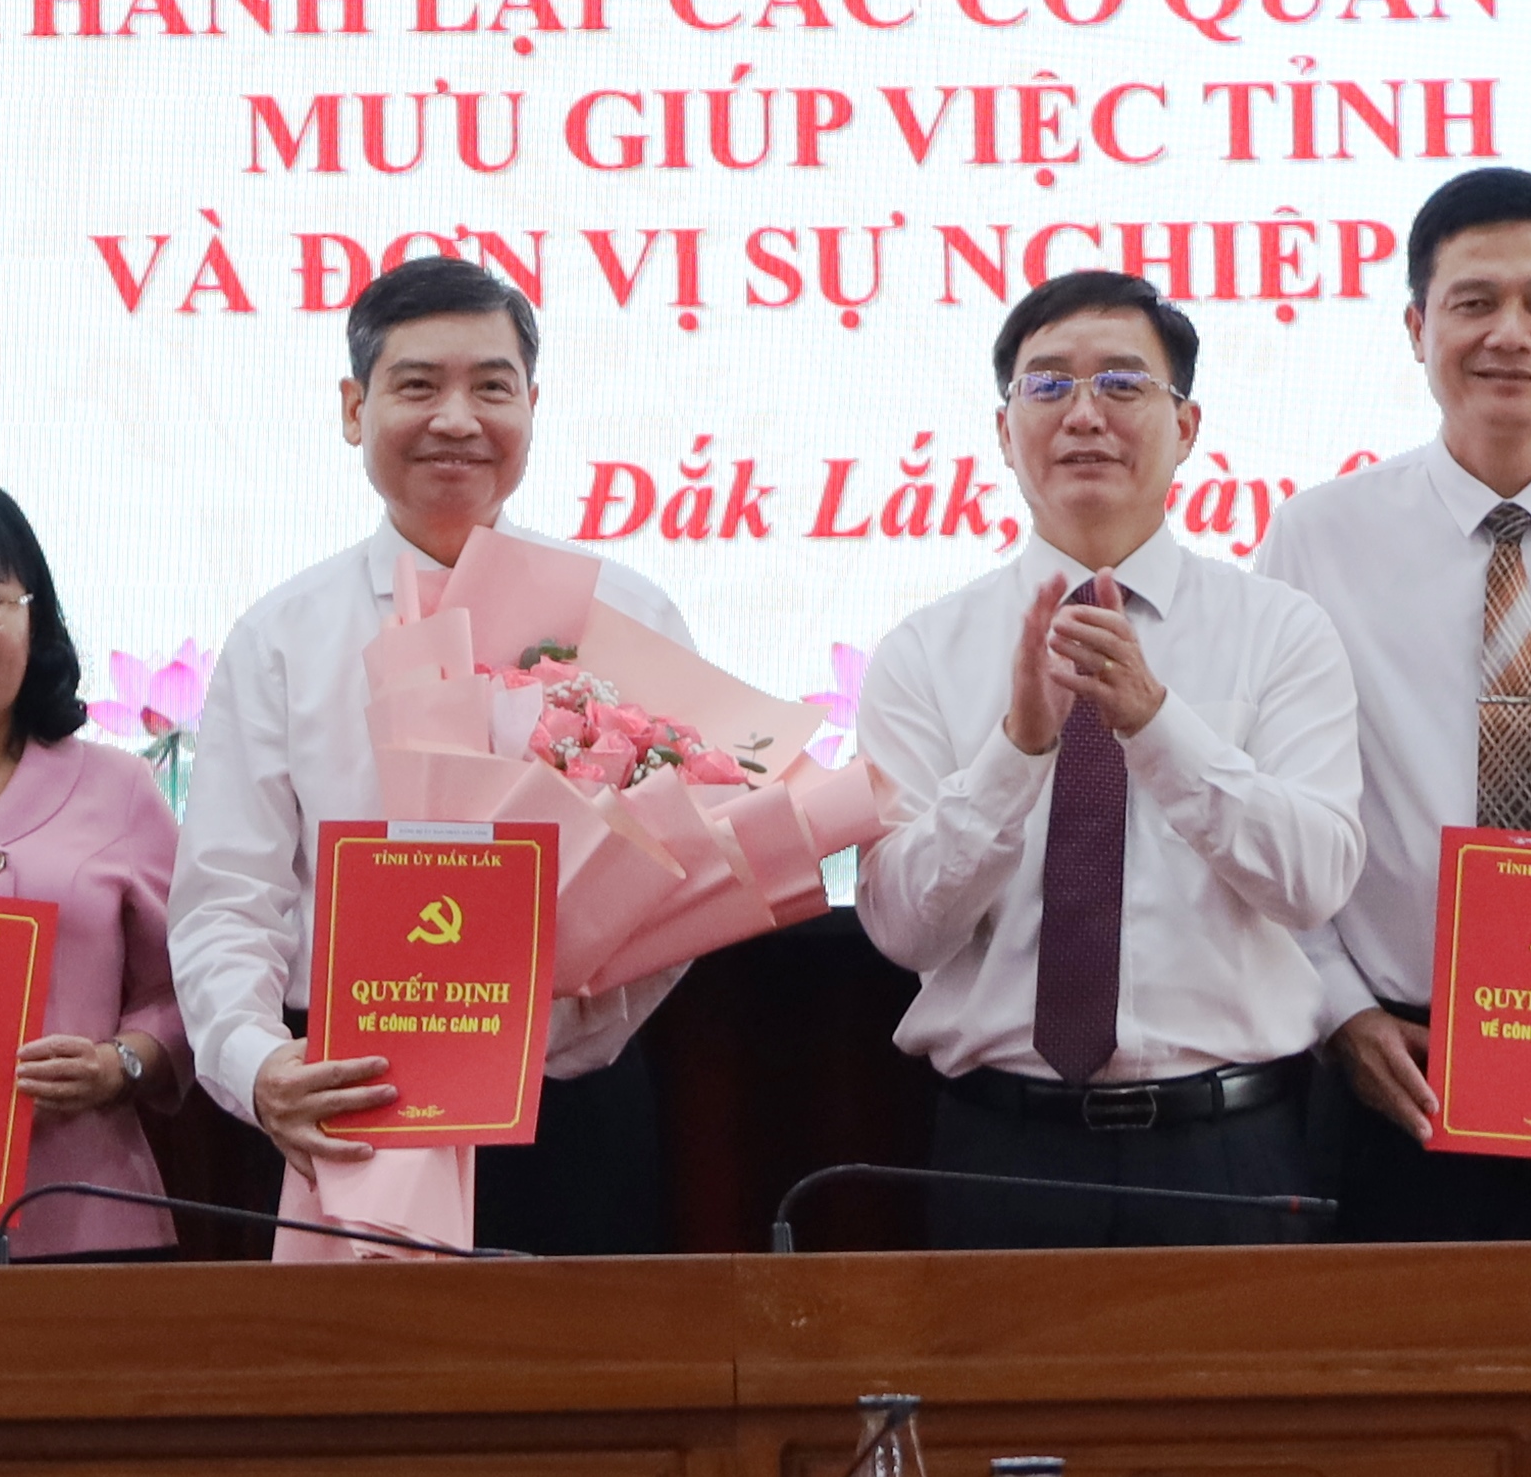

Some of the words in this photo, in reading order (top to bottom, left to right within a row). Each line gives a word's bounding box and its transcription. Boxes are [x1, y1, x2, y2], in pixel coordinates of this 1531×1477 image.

[246, 79, 523, 173] MƯU
[565, 63, 853, 171] GIÚP
[880, 71, 1166, 187] VIỆC
[1205, 57, 1496, 160] TỈNH
[92, 209, 255, 312] VÀ
[582, 229, 701, 331] VỊ
[746, 212, 905, 329] SỰ
[574, 434, 772, 541] Đắk
[808, 432, 1019, 547] Lắk,
[372, 849, 409, 866] TỈNH
[413, 850, 433, 866] ỦY
[351, 972, 439, 1005] QUYẾT
[445, 982, 510, 1008] ĐỊNH
[358, 1011, 377, 1032] VỀ
[379, 1013, 418, 1033] CÔNG
[421, 1013, 447, 1033] TÁC
[449, 1014, 479, 1033] CÁN
[481, 1014, 501, 1036] BỘ
[1480, 1018, 1499, 1038] VỀ
